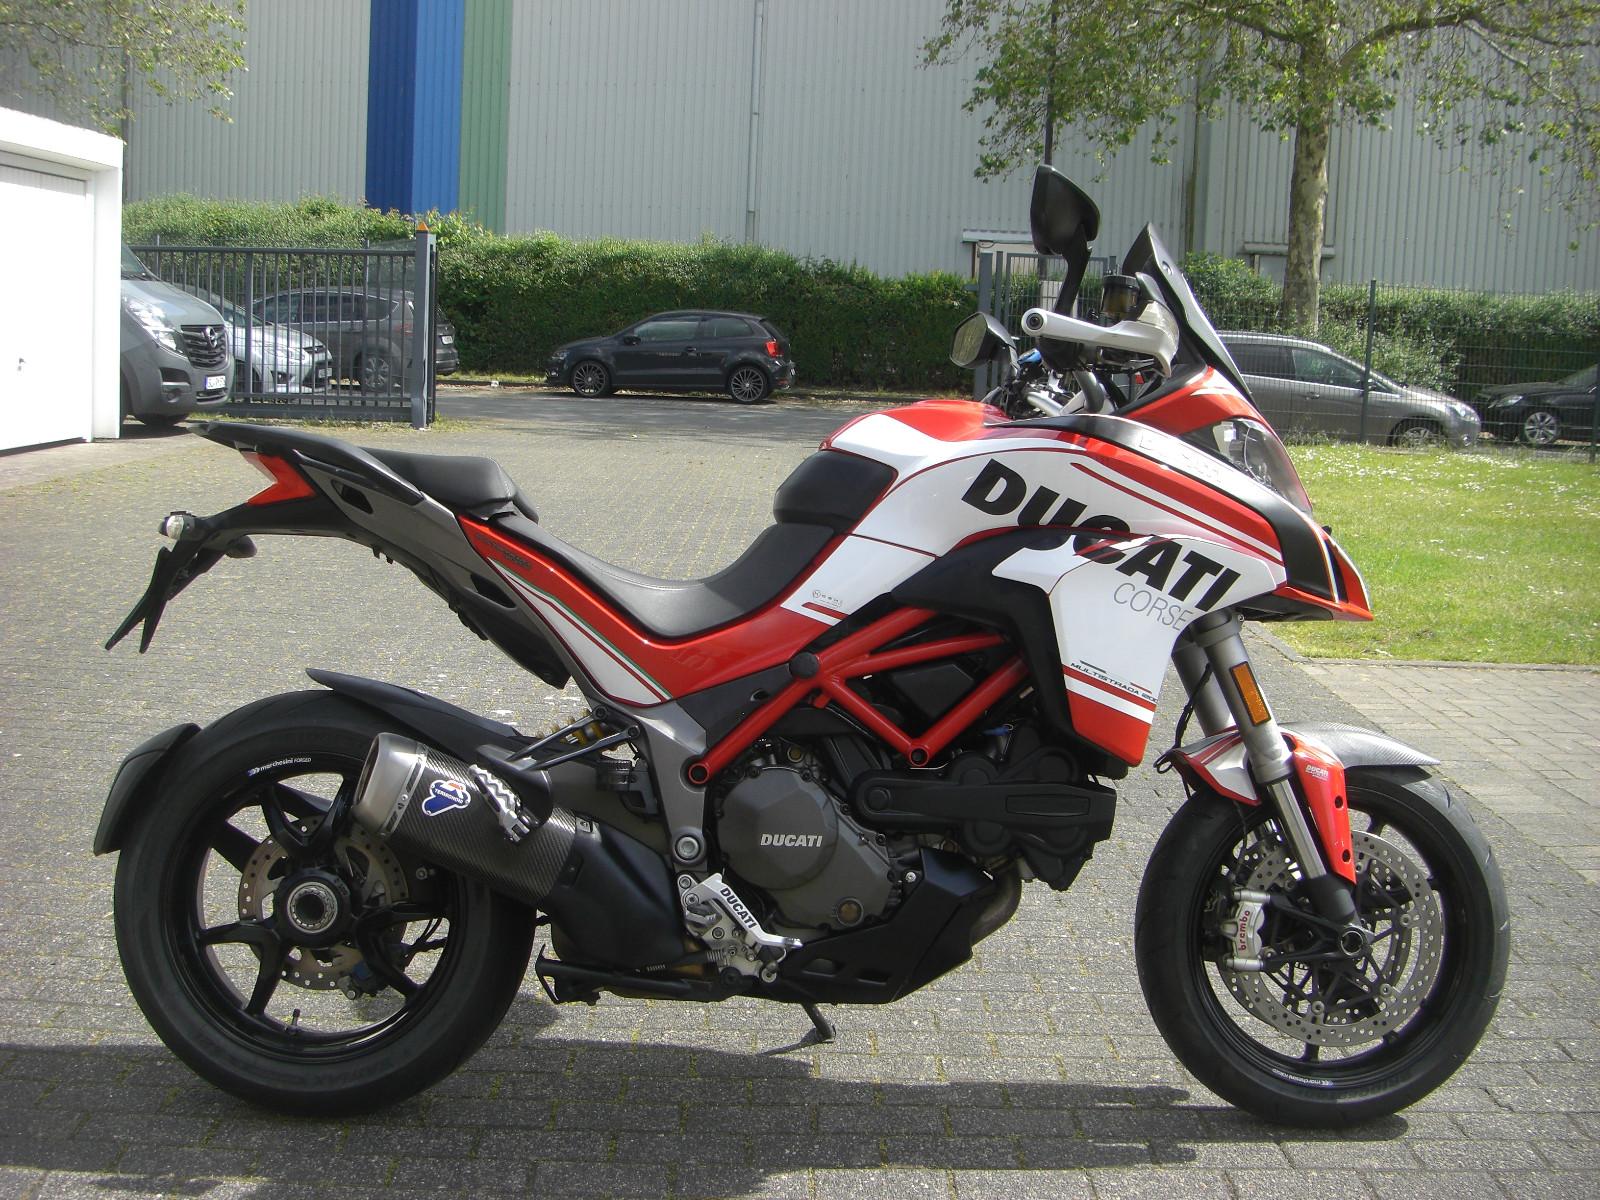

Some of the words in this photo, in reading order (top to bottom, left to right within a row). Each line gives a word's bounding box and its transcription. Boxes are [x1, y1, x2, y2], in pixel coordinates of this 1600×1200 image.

[961, 458, 1241, 612] DUCATI
[1113, 582, 1194, 632] CORSE
[1070, 662, 1139, 695] MULTISTRADA
[760, 833, 823, 848] DUCATI
[719, 886, 757, 929] DUCATI
[1238, 910, 1251, 951] brembo
